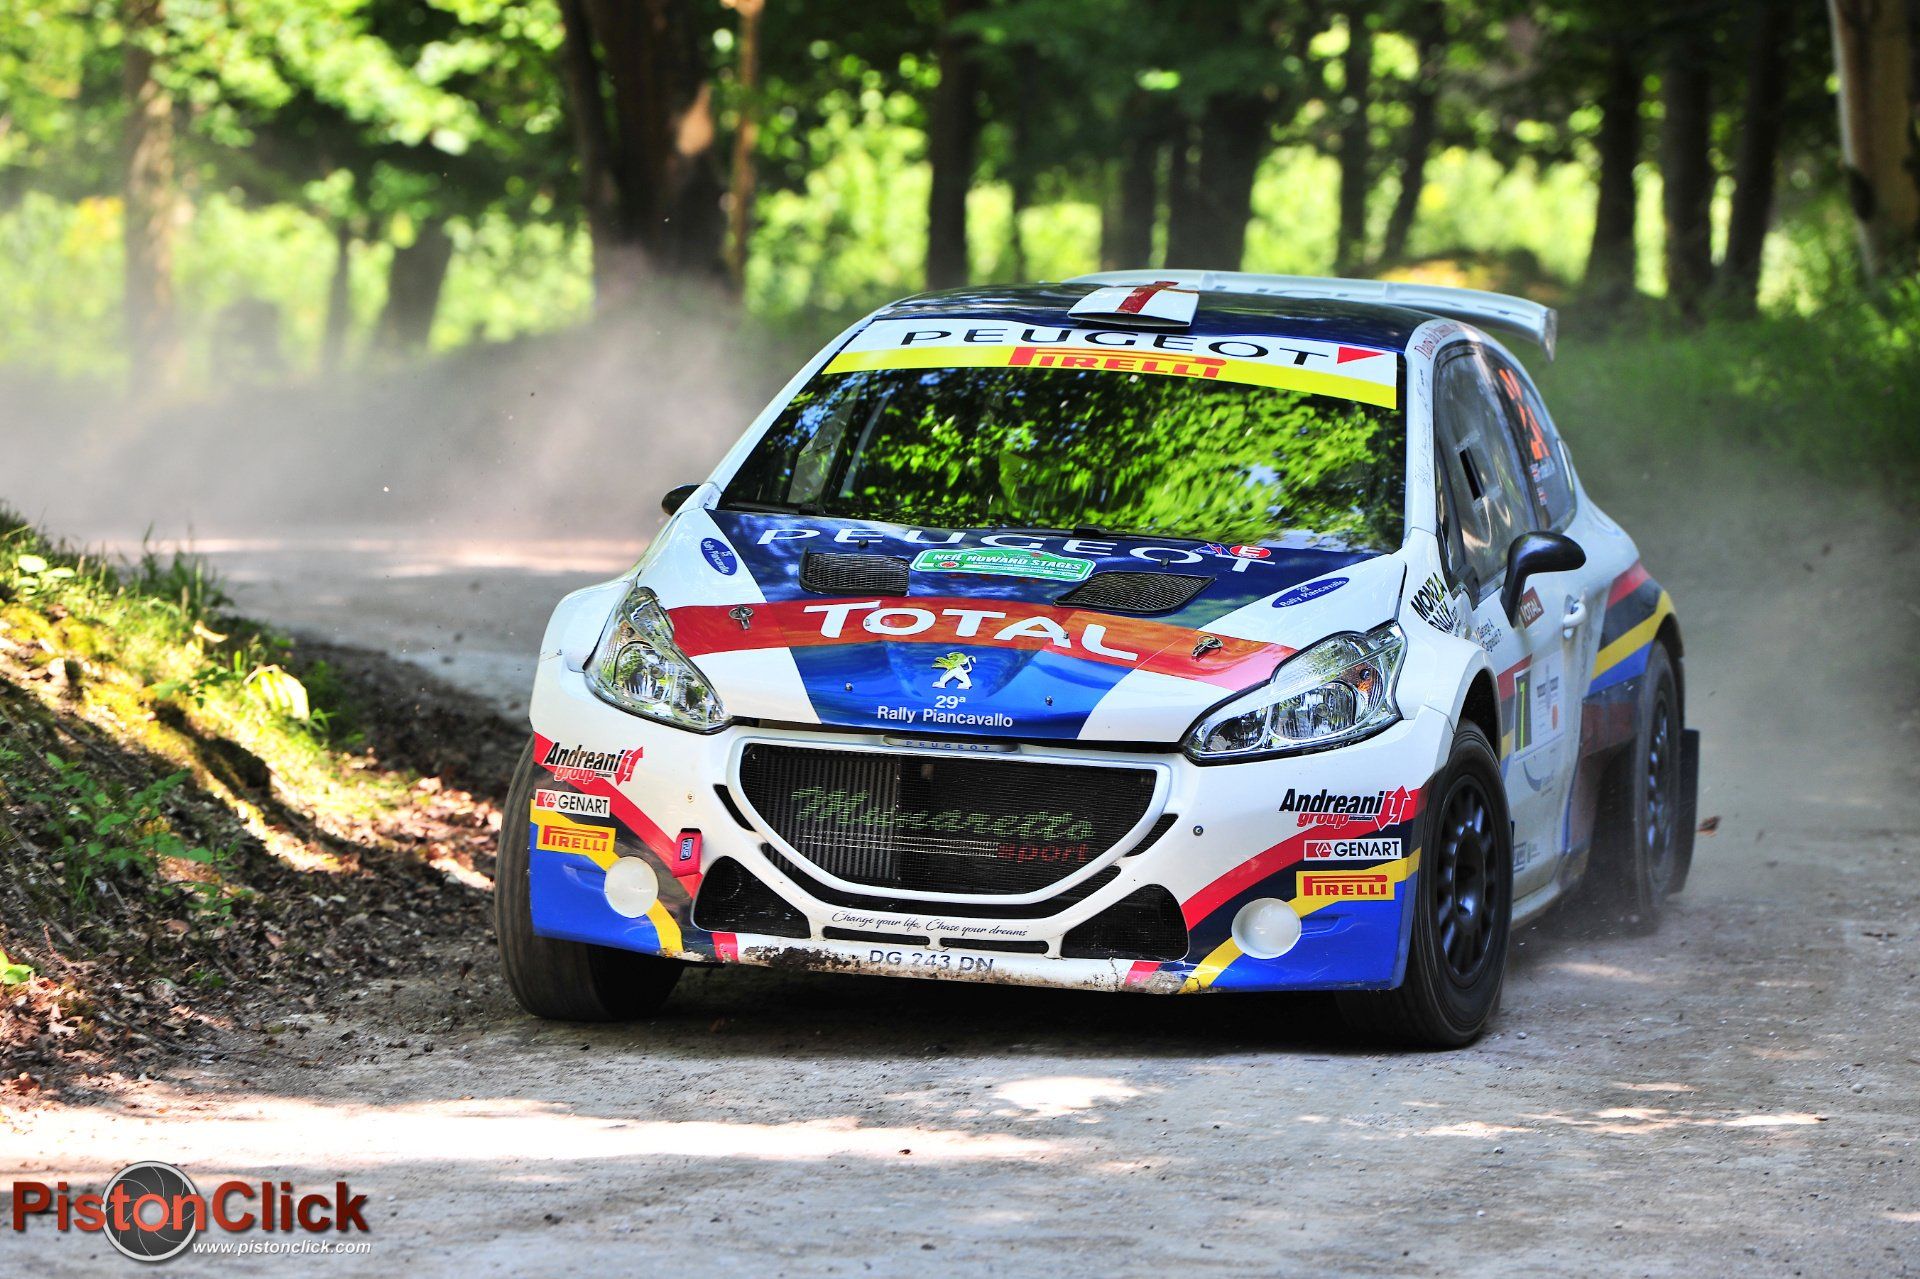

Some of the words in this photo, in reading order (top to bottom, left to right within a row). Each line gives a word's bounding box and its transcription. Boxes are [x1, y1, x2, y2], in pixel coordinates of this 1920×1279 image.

[900, 327, 1329, 366] PEUGEOT
[1007, 346, 1227, 379] PIRELLI
[757, 528, 1276, 573] PEUGEOT
[932, 552, 963, 562] NEIL
[966, 554, 1029, 565] HOWARD
[1032, 558, 1083, 571] STAGES
[1410, 571, 1448, 622] MONZA
[803, 601, 1139, 662] TOTAL
[877, 705, 917, 724] Rally
[922, 707, 1014, 728] Piancavallo
[543, 741, 626, 770] Andreani
[905, 739, 991, 751] PEUGEOT
[554, 766, 596, 785] group
[558, 794, 609, 815] GENART
[1278, 788, 1386, 815] Andreani
[1296, 812, 1350, 830] group
[542, 824, 610, 852] PIRELLI
[1333, 841, 1400, 857] GENART
[996, 843, 1088, 863] sport
[1303, 874, 1388, 897] PIRELLI
[831, 910, 874, 928] Change
[876, 919, 902, 931] your
[925, 918, 959, 932] Chase
[961, 925, 990, 937] your
[988, 925, 1030, 937] dreams
[869, 949, 902, 966] DG
[911, 952, 951, 969] 243
[959, 956, 995, 973] DN
